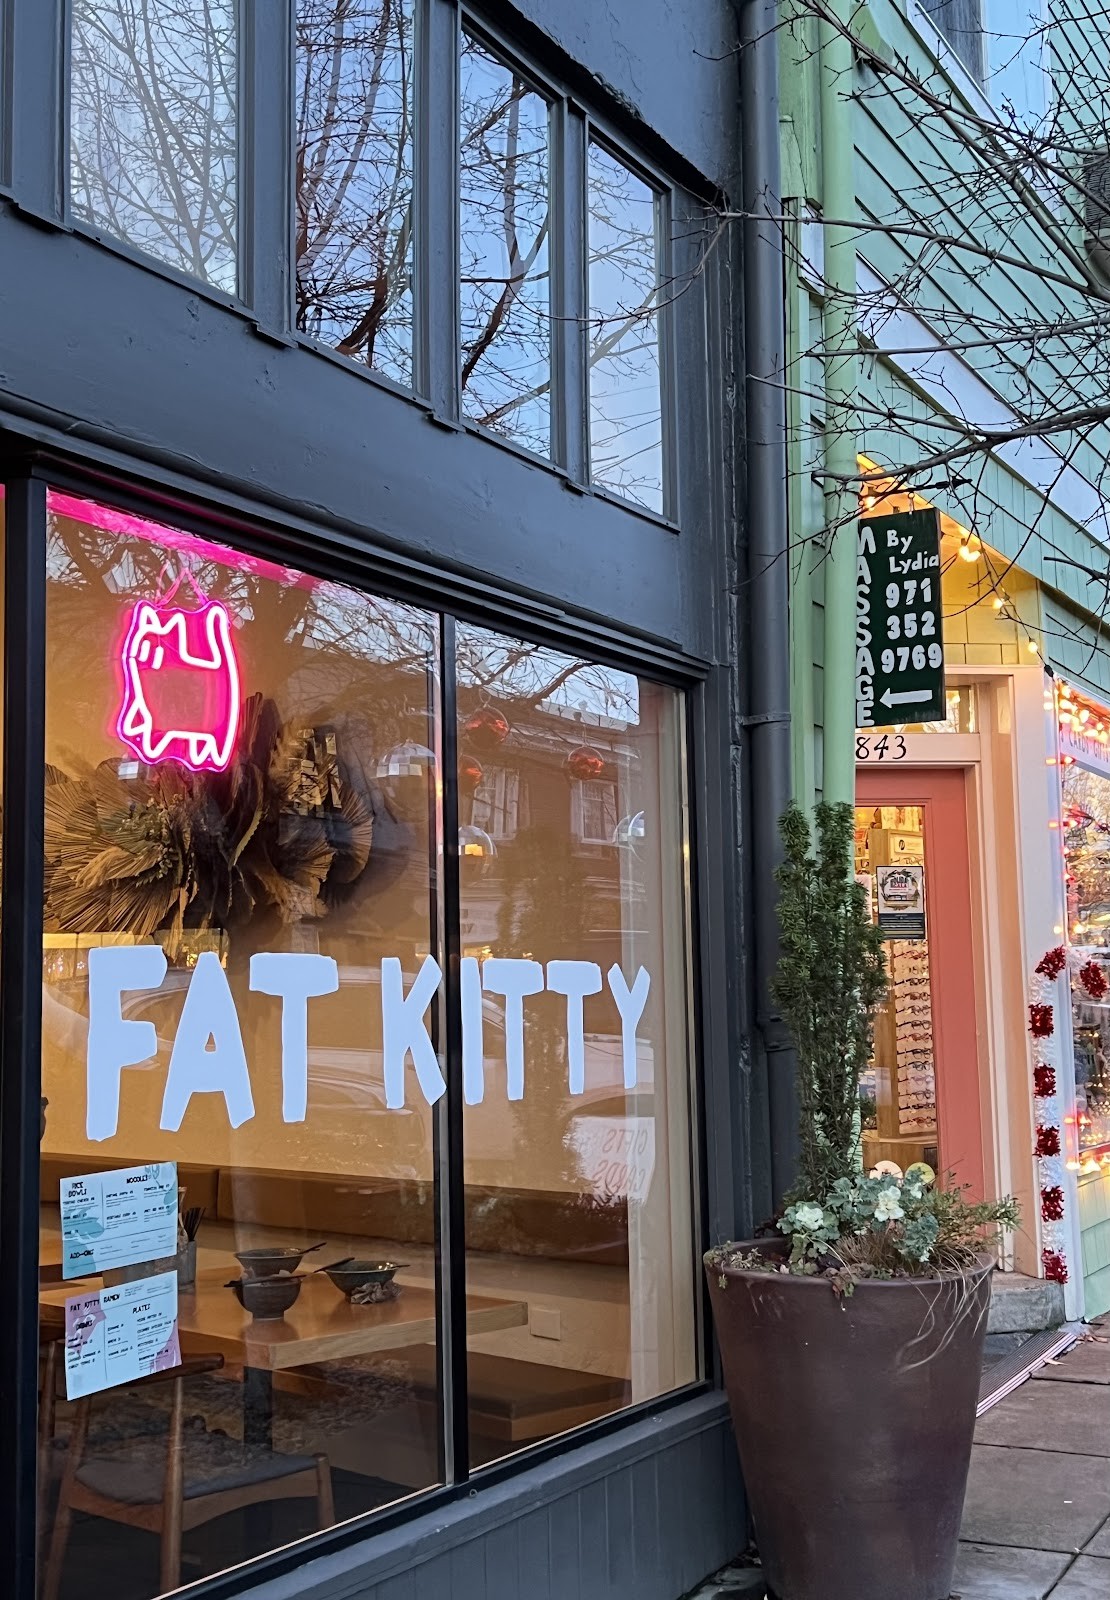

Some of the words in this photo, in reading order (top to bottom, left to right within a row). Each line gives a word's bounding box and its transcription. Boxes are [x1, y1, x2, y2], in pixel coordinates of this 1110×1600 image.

[886, 529, 914, 555] By
[888, 551, 940, 574] Lydia
[885, 577, 932, 609] 971
[886, 610, 936, 640] 352
[880, 642, 943, 674] 9769
[855, 734, 907, 761] 843
[86, 945, 339, 1142] FAT
[381, 954, 651, 1109] KITTY
[70, 1303, 82, 1312] FAT
[84, 1299, 100, 1309] KITTY
[103, 1293, 121, 1304] RAMEN
[132, 1303, 151, 1314] PLATES
